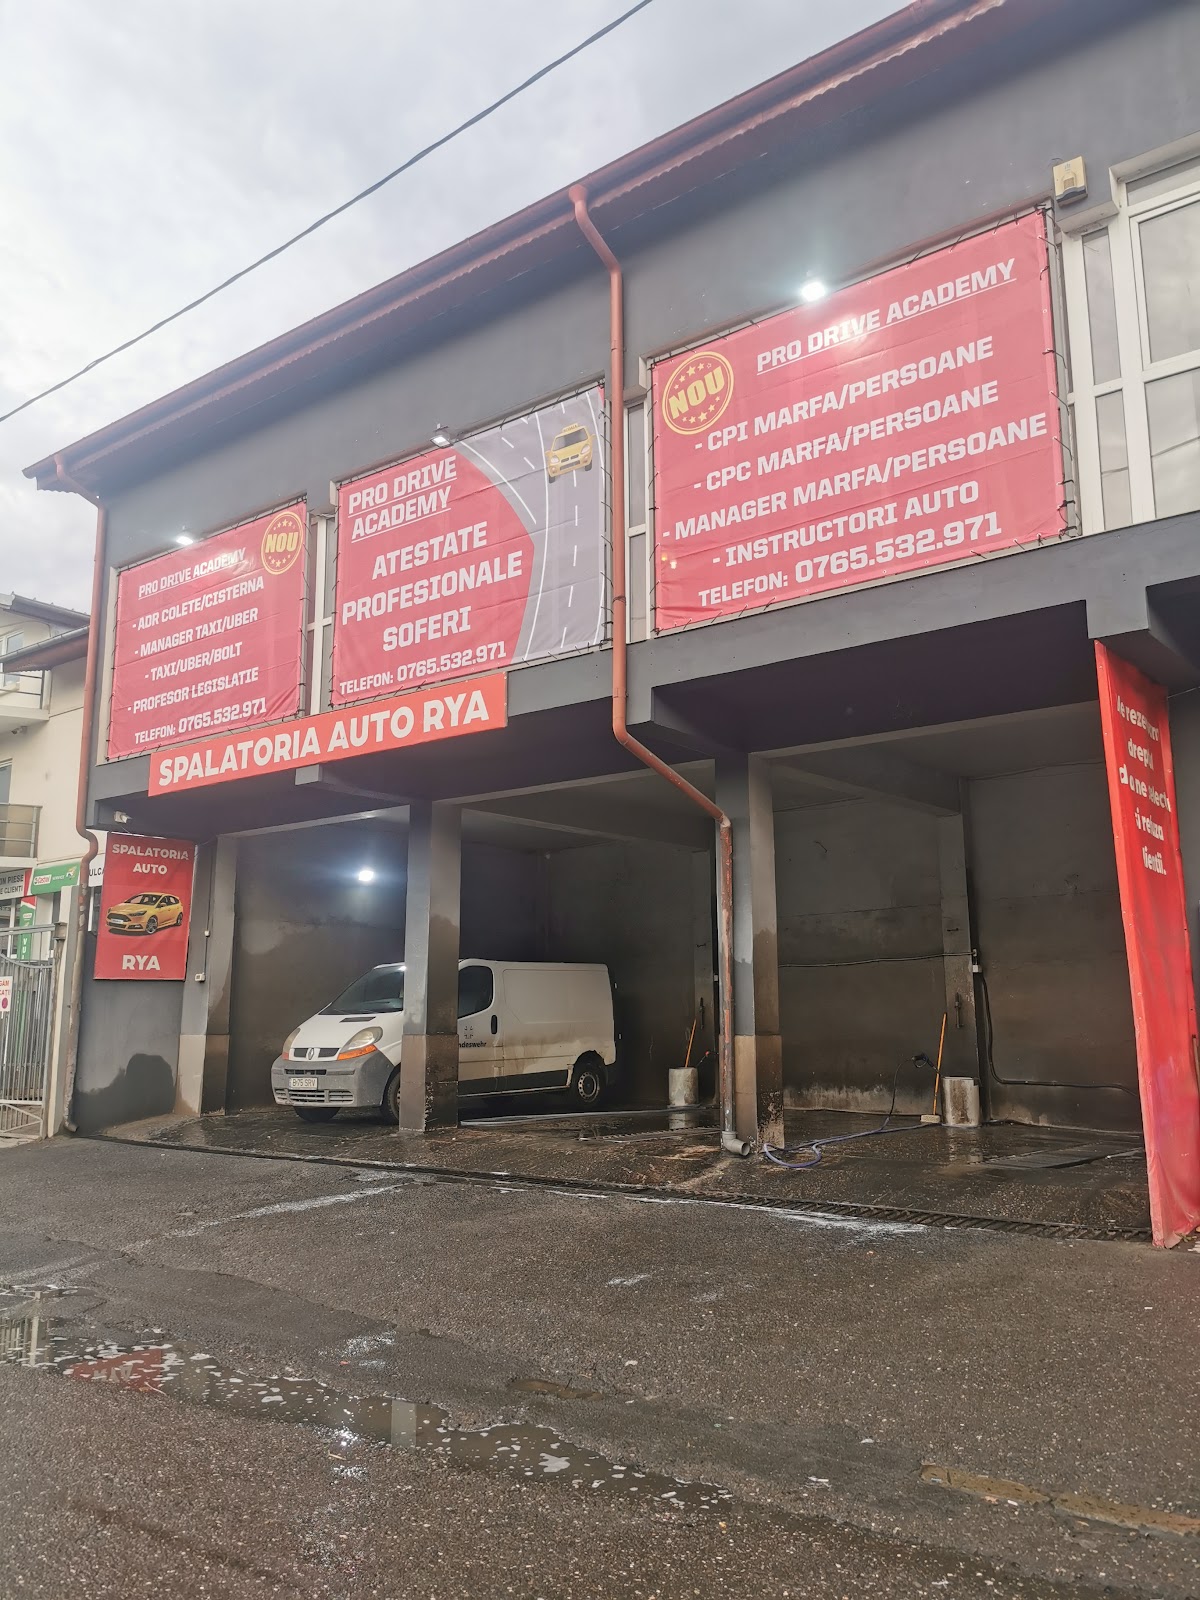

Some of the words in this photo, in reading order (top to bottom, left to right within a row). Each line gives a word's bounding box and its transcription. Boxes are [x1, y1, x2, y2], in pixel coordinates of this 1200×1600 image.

[757, 340, 802, 371] PRO
[807, 309, 880, 354] DRIVE
[886, 258, 1016, 325] ACADEMY
[667, 366, 726, 420] NOU
[754, 336, 994, 437] MARFA/PERSOANE
[758, 380, 999, 476] MARFA/PERSOANE
[348, 482, 388, 514] PRO
[393, 455, 457, 499] DRIVE
[675, 490, 787, 541] MANAGER
[793, 412, 1048, 507] MARFA/PERSOANE
[351, 486, 452, 540] ACADEMY
[725, 506, 899, 567] INSTRUCTORI
[904, 480, 979, 521] AUTO
[265, 531, 299, 553] NOU
[372, 521, 488, 580] ATESTATE
[698, 573, 788, 607] TELEFON:
[794, 511, 1002, 584] 0765.532.971
[138, 580, 159, 598] PRO
[160, 568, 191, 590] DRIVE
[193, 547, 246, 578] ACADEMY
[161, 576, 264, 622] COLETE/CISTERNA
[342, 551, 523, 625] PROFESIONALE
[195, 608, 258, 640] TAXI/UBER
[382, 606, 471, 651] SOFERI
[191, 667, 259, 698] LEGISLATIE
[340, 671, 393, 695] TELEFON:
[397, 641, 506, 682] 0765.532.971
[135, 724, 176, 744] TELEFON:
[178, 697, 267, 734] 0765.532.971
[158, 727, 321, 786] SPALATORIA
[327, 706, 414, 752] AUTO
[423, 689, 489, 733] RYA
[7, 874, 24, 884] PIESE
[112, 844, 190, 860] SPALATORIA
[133, 862, 168, 875] AUTO
[121, 954, 161, 971] RYA
